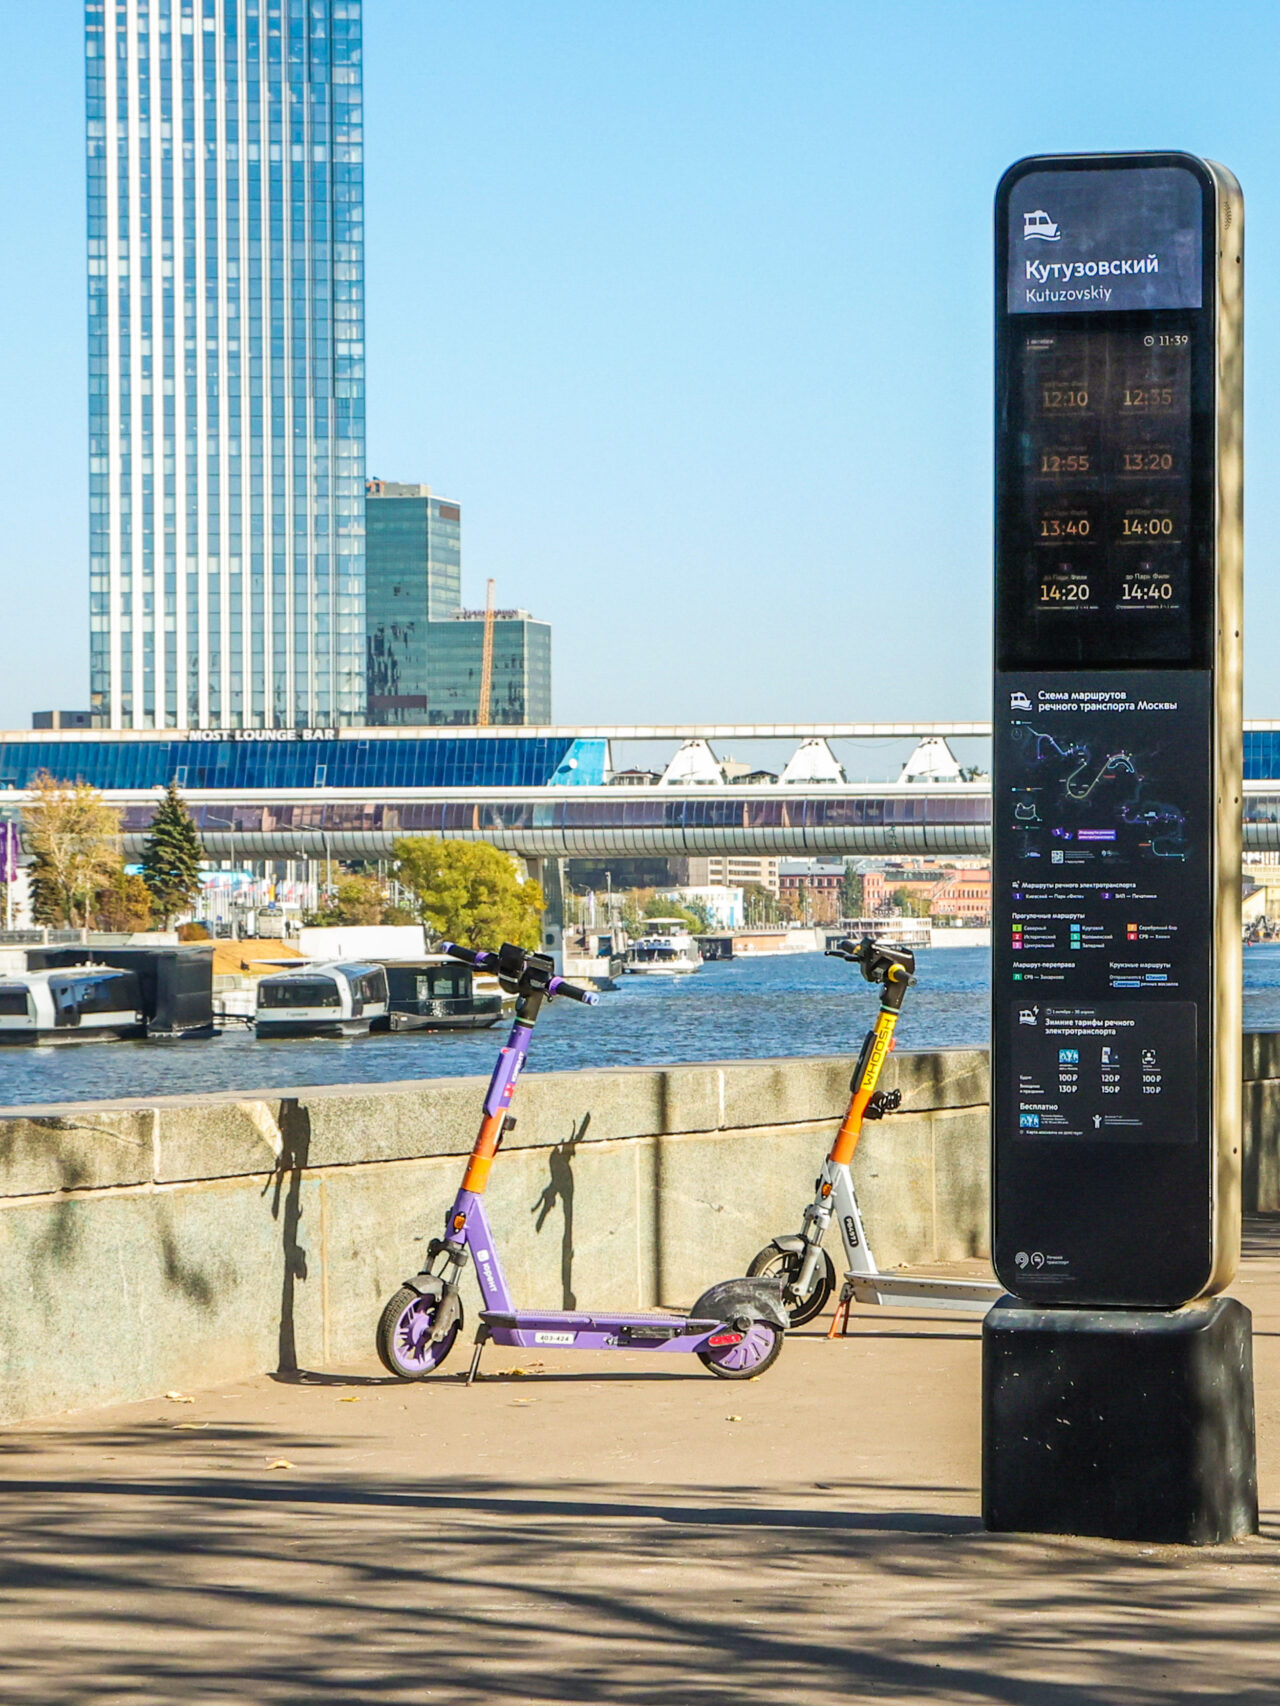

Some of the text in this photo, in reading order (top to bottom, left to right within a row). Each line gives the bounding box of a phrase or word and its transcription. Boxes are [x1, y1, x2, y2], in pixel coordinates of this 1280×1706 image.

[1025, 254, 1159, 283] Кутузовский
[1026, 285, 1112, 303] Kutuzovskiy
[1159, 335, 1189, 346] 11:39
[1041, 455, 1090, 472] 12:55
[1123, 453, 1173, 470] 13:20
[1040, 520, 1090, 536] 13:40
[1122, 518, 1173, 535] 14:00
[1040, 585, 1090, 601] 14:20
[1122, 583, 1173, 600] 14:40
[1038, 690, 1127, 702] Схема маршрутов
[1038, 700, 1178, 713] речного транспорта Москвы
[189, 729, 335, 742] MOST LOUNGE BAR
[1075, 1018, 1103, 1027] тарифы
[1104, 1019, 1135, 1028] речного
[1045, 1028, 1116, 1036] электротранспорта
[863, 1018, 896, 1087] WHOOSH
[1019, 1102, 1058, 1111] Бесплатно
